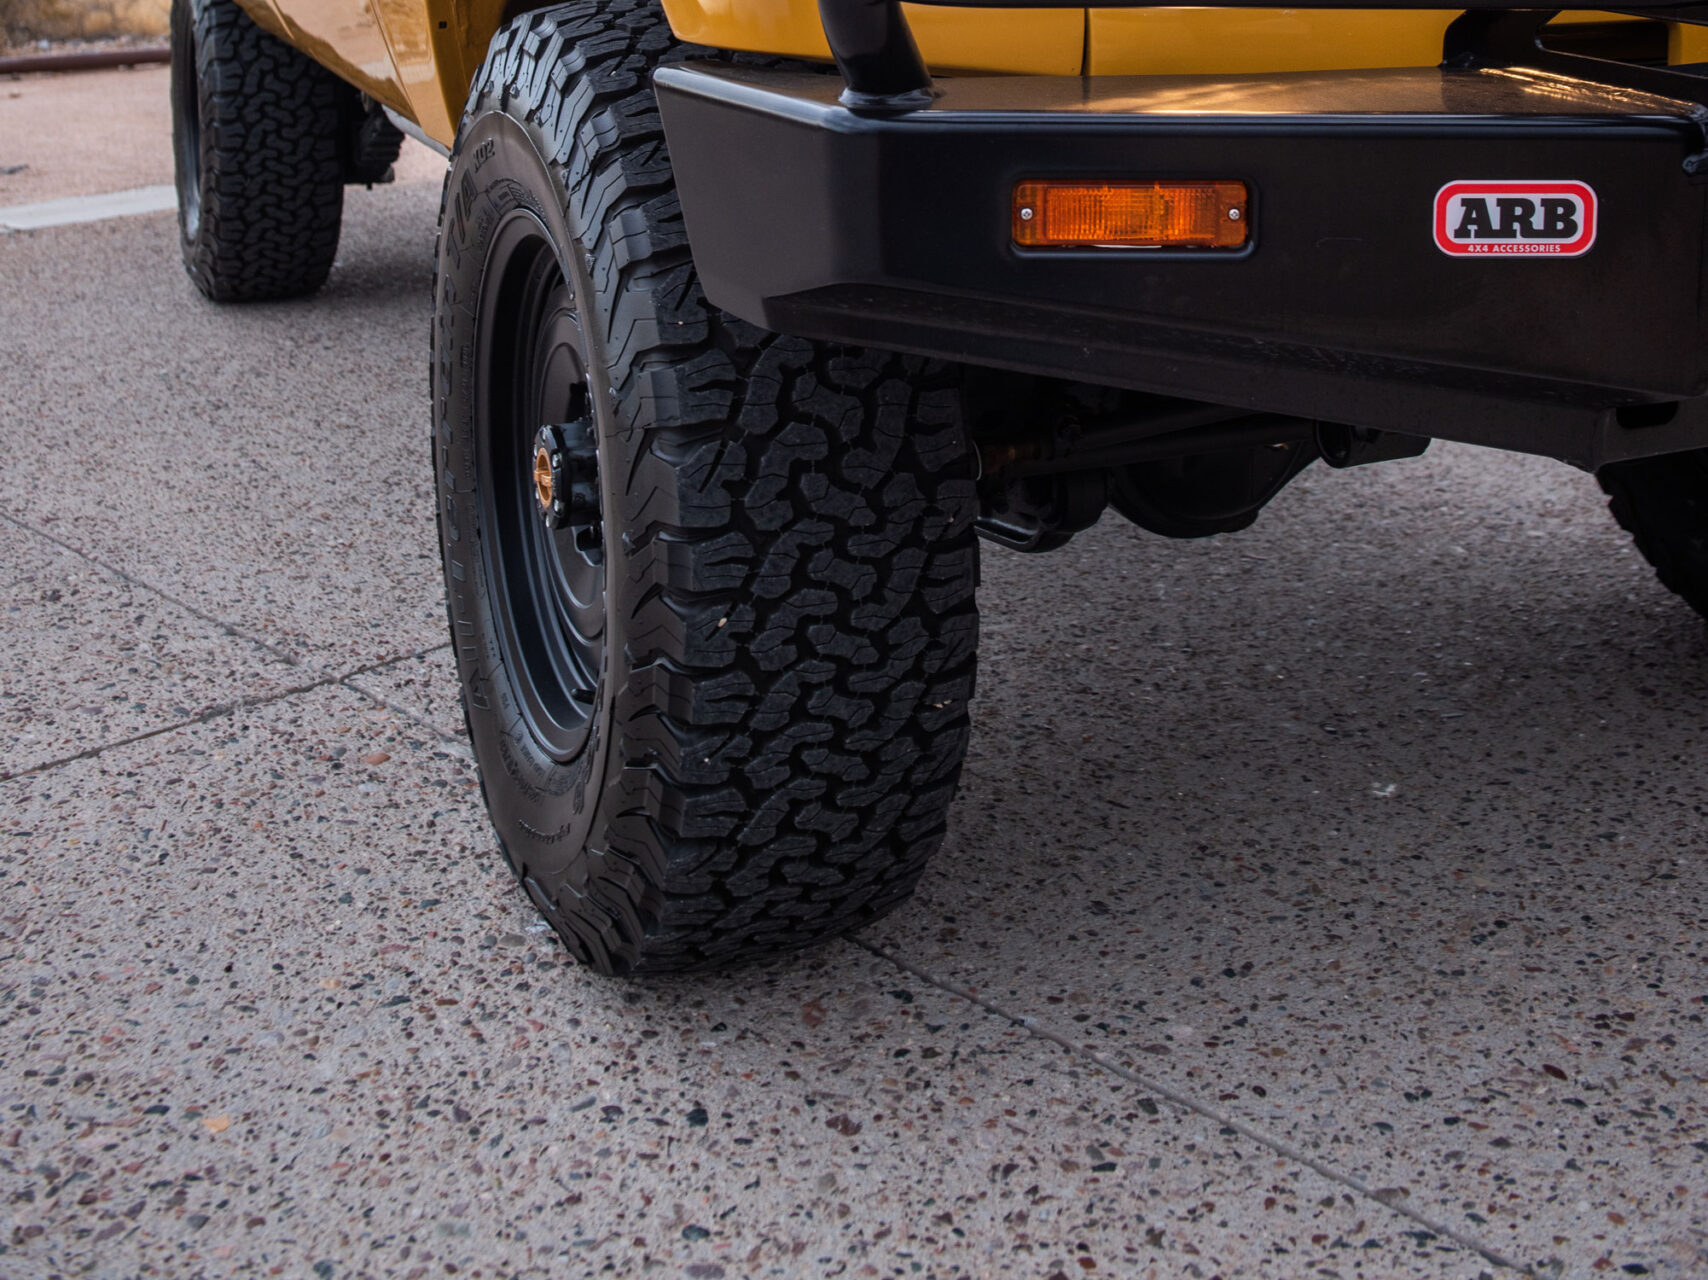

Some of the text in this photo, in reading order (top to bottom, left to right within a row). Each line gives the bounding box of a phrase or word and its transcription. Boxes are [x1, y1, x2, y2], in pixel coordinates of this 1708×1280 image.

[1453, 197, 1579, 239] ARB
[1467, 244, 1561, 253] 4X4 ACCESSORIES
